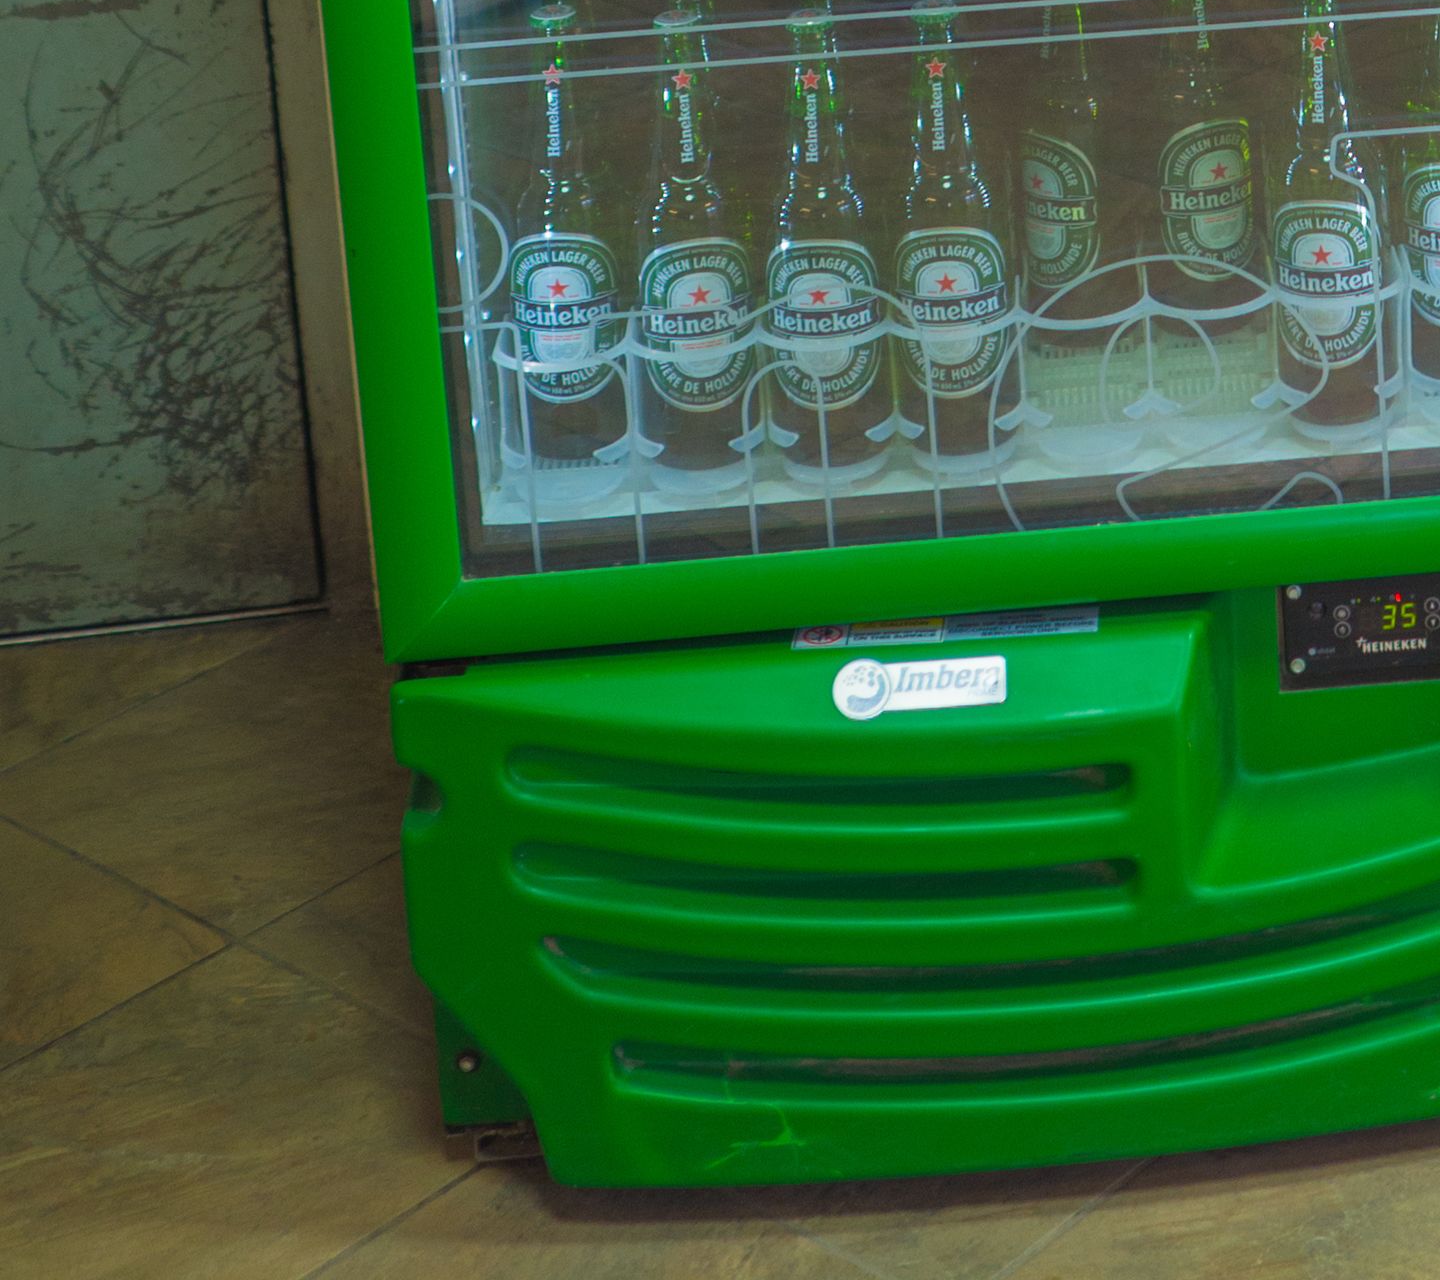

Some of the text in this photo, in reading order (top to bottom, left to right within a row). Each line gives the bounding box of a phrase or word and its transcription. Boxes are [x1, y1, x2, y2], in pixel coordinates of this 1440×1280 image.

[1312, 54, 1325, 125] Heineken
[547, 89, 561, 158] Heineken
[680, 92, 695, 164] Heineken
[805, 92, 819, 164] Heineken
[931, 82, 946, 152] Heineken
[1315, 217, 1368, 253] LAGER BEER
[516, 250, 605, 287] HEINEKEN LAGER BEER
[651, 255, 742, 297] HEINEKEN LAGER BEER
[774, 257, 847, 293] HEINEKEN LAGER
[940, 244, 993, 278] LAGER BEER
[1279, 265, 1374, 292] Heineken
[515, 301, 611, 326] Heineken
[773, 307, 873, 334] Heineken
[1325, 309, 1372, 352] HOLLANDE
[822, 348, 870, 393] HOLLANDE
[951, 336, 997, 381] HOLLANDE
[1383, 603, 1416, 630] 35
[1362, 638, 1427, 653] HEINEKEN
